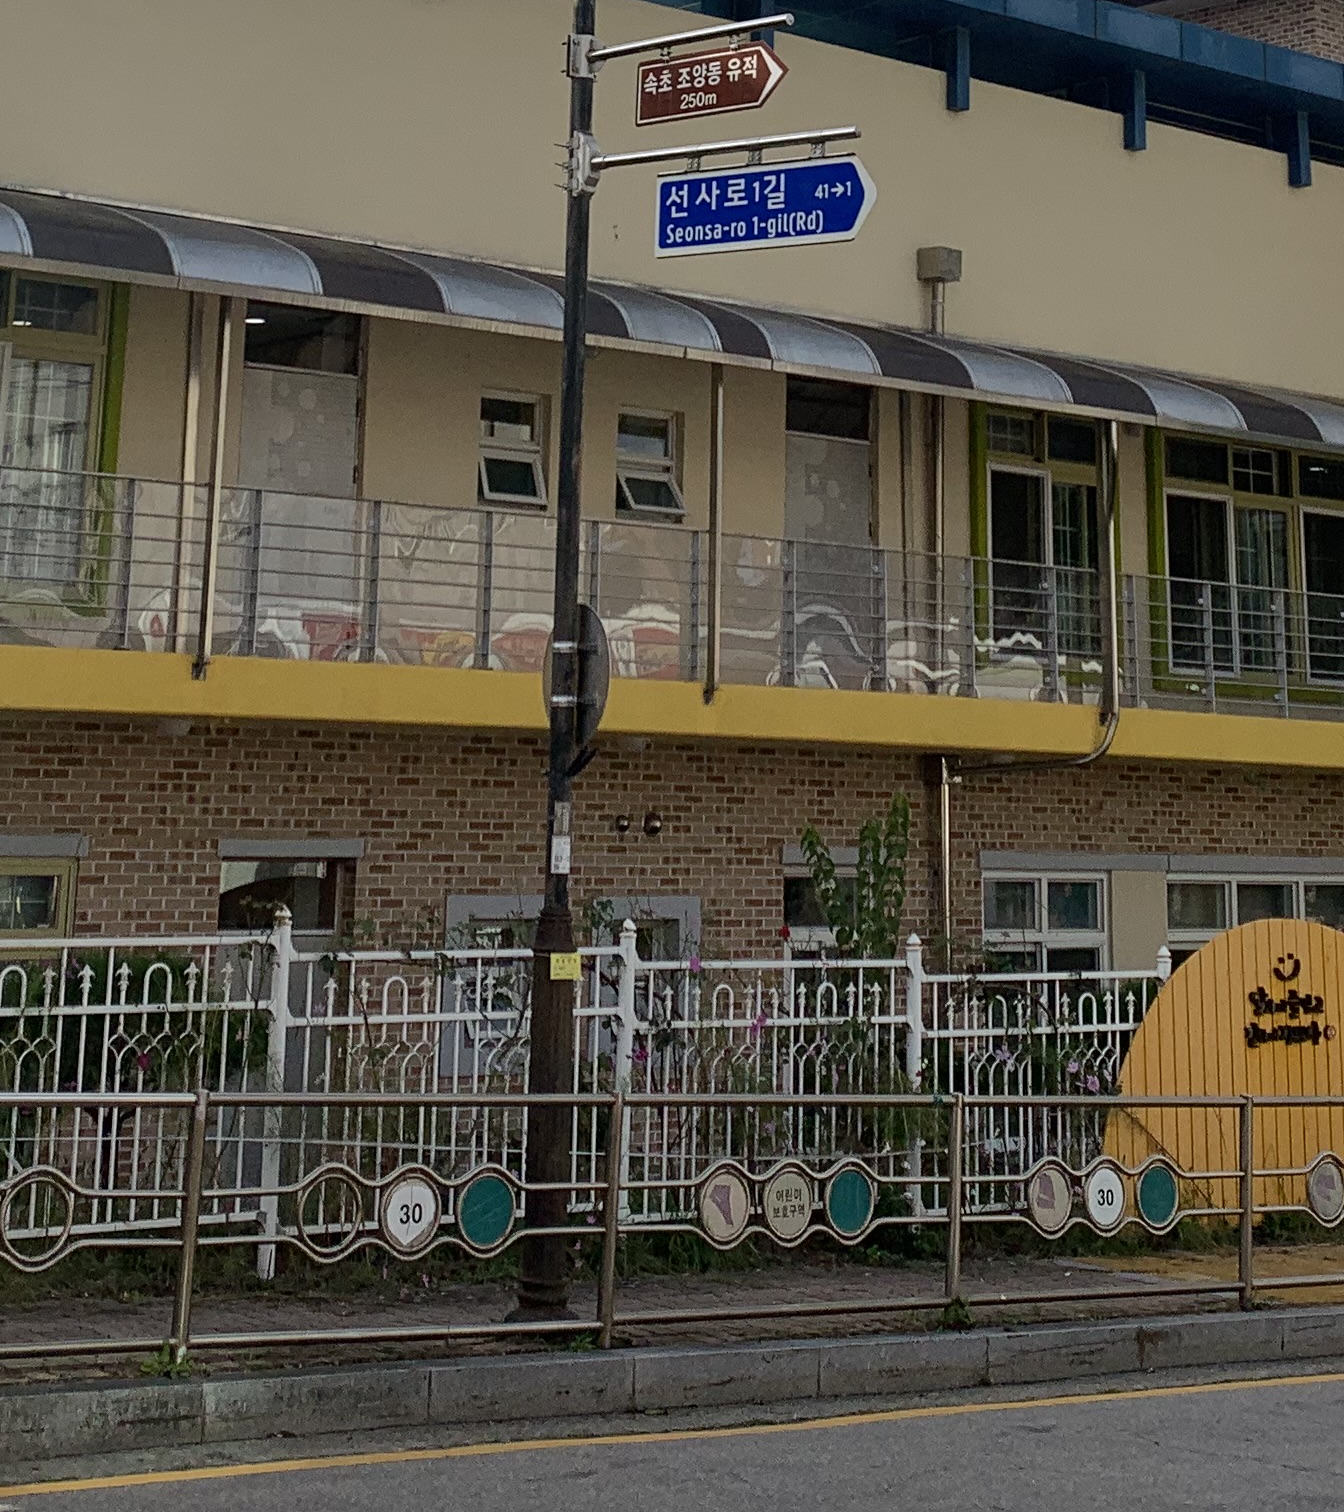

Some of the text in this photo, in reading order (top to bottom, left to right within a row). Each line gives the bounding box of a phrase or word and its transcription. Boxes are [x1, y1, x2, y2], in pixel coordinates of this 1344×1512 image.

[643, 54, 757, 95] 속초 조양동 유적
[680, 92, 717, 111] 250m
[666, 210, 824, 244] Seonsa-ro 1-gil(Rd)
[775, 1187, 802, 1203] 어린이
[1097, 1189, 1114, 1206] 30
[399, 1203, 423, 1224] 30
[772, 1203, 805, 1219] 보호구역
